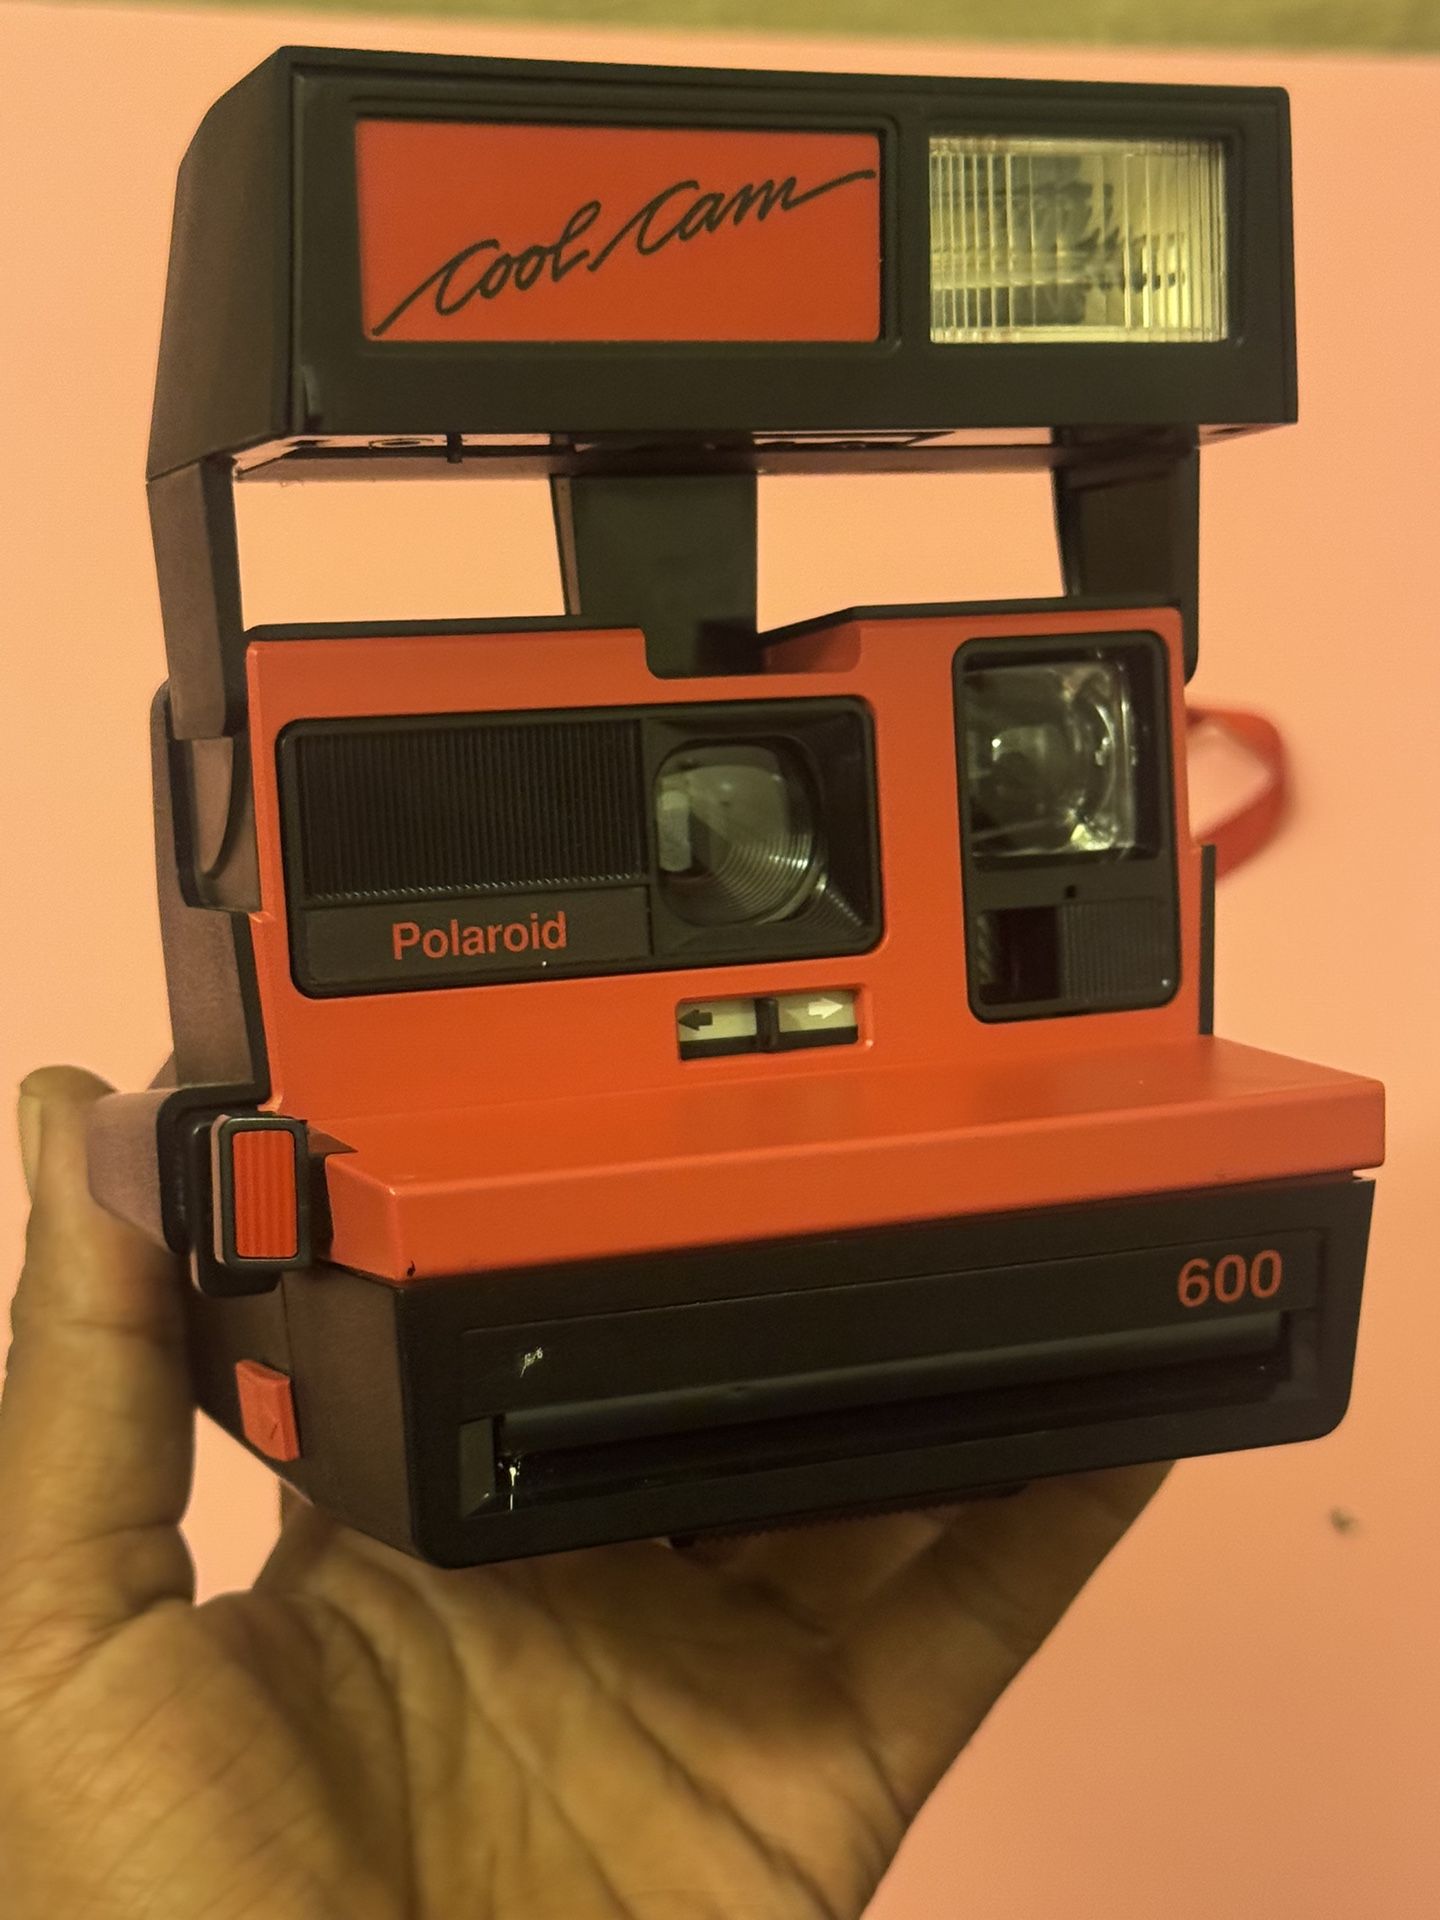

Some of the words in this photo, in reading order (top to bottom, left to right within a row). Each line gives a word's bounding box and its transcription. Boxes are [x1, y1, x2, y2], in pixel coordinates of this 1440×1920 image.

[372, 200, 602, 337] Cool
[587, 169, 877, 271] Cam
[392, 910, 567, 960] Polaroid
[1177, 1249, 1283, 1308] 600
